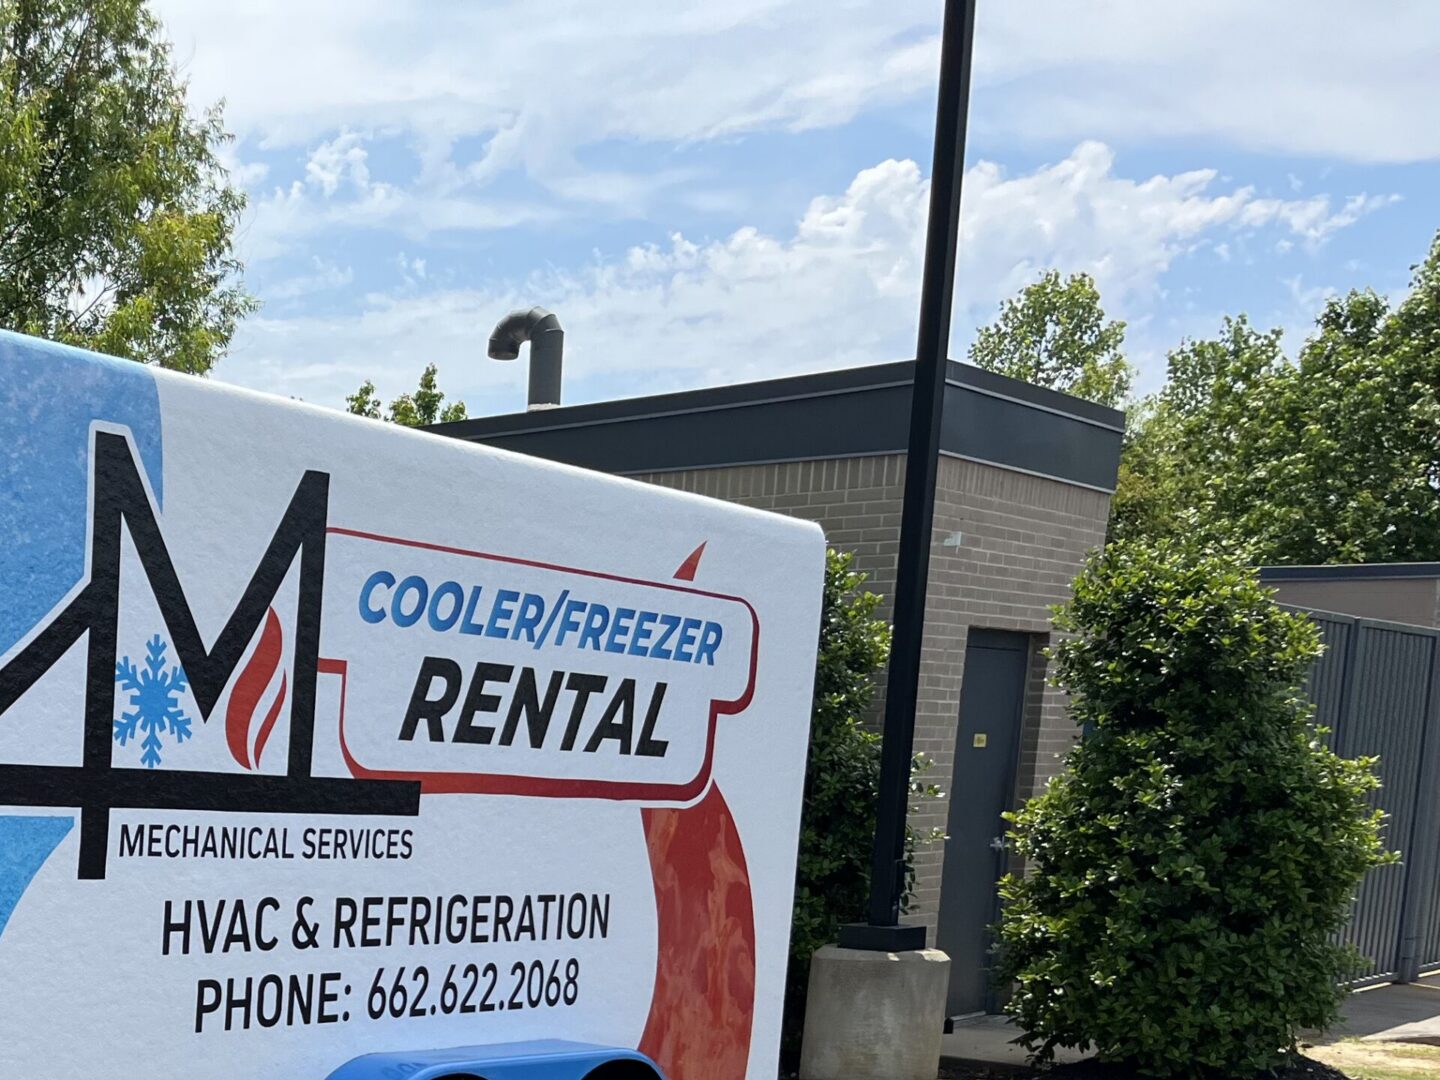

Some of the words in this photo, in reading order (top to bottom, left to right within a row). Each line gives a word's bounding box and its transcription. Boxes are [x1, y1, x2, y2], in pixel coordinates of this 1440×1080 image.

[358, 570, 723, 666] COOLER/FREEZER
[397, 655, 670, 758] RENTAL
[119, 823, 295, 859] MECHANICAL
[301, 828, 414, 860] SERVICES
[162, 896, 281, 956] HVAC
[291, 896, 320, 950] &
[333, 892, 610, 949] REFRIGERATION
[194, 972, 352, 1034] PHONE:
[367, 957, 580, 1020] 662.622.2068
